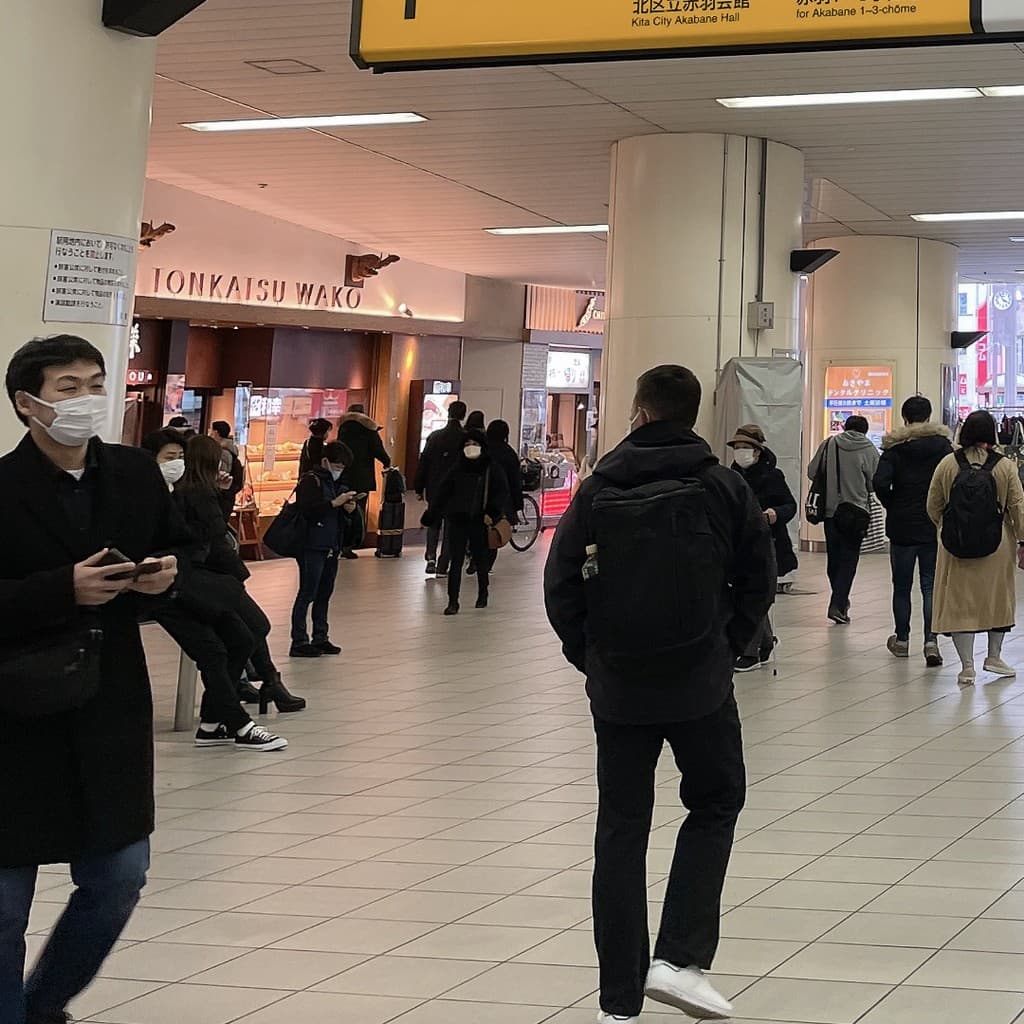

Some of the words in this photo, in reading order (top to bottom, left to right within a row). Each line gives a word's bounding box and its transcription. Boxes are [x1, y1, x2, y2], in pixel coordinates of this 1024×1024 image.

[631, 17, 650, 27] Kita
[653, 15, 672, 26] City
[675, 14, 718, 25] Akabane
[721, 12, 740, 22] Hall
[796, 9, 809, 18] for
[812, 7, 857, 18] Akabane
[152, 267, 286, 304] TONKATSU
[296, 282, 361, 309] WAKO
